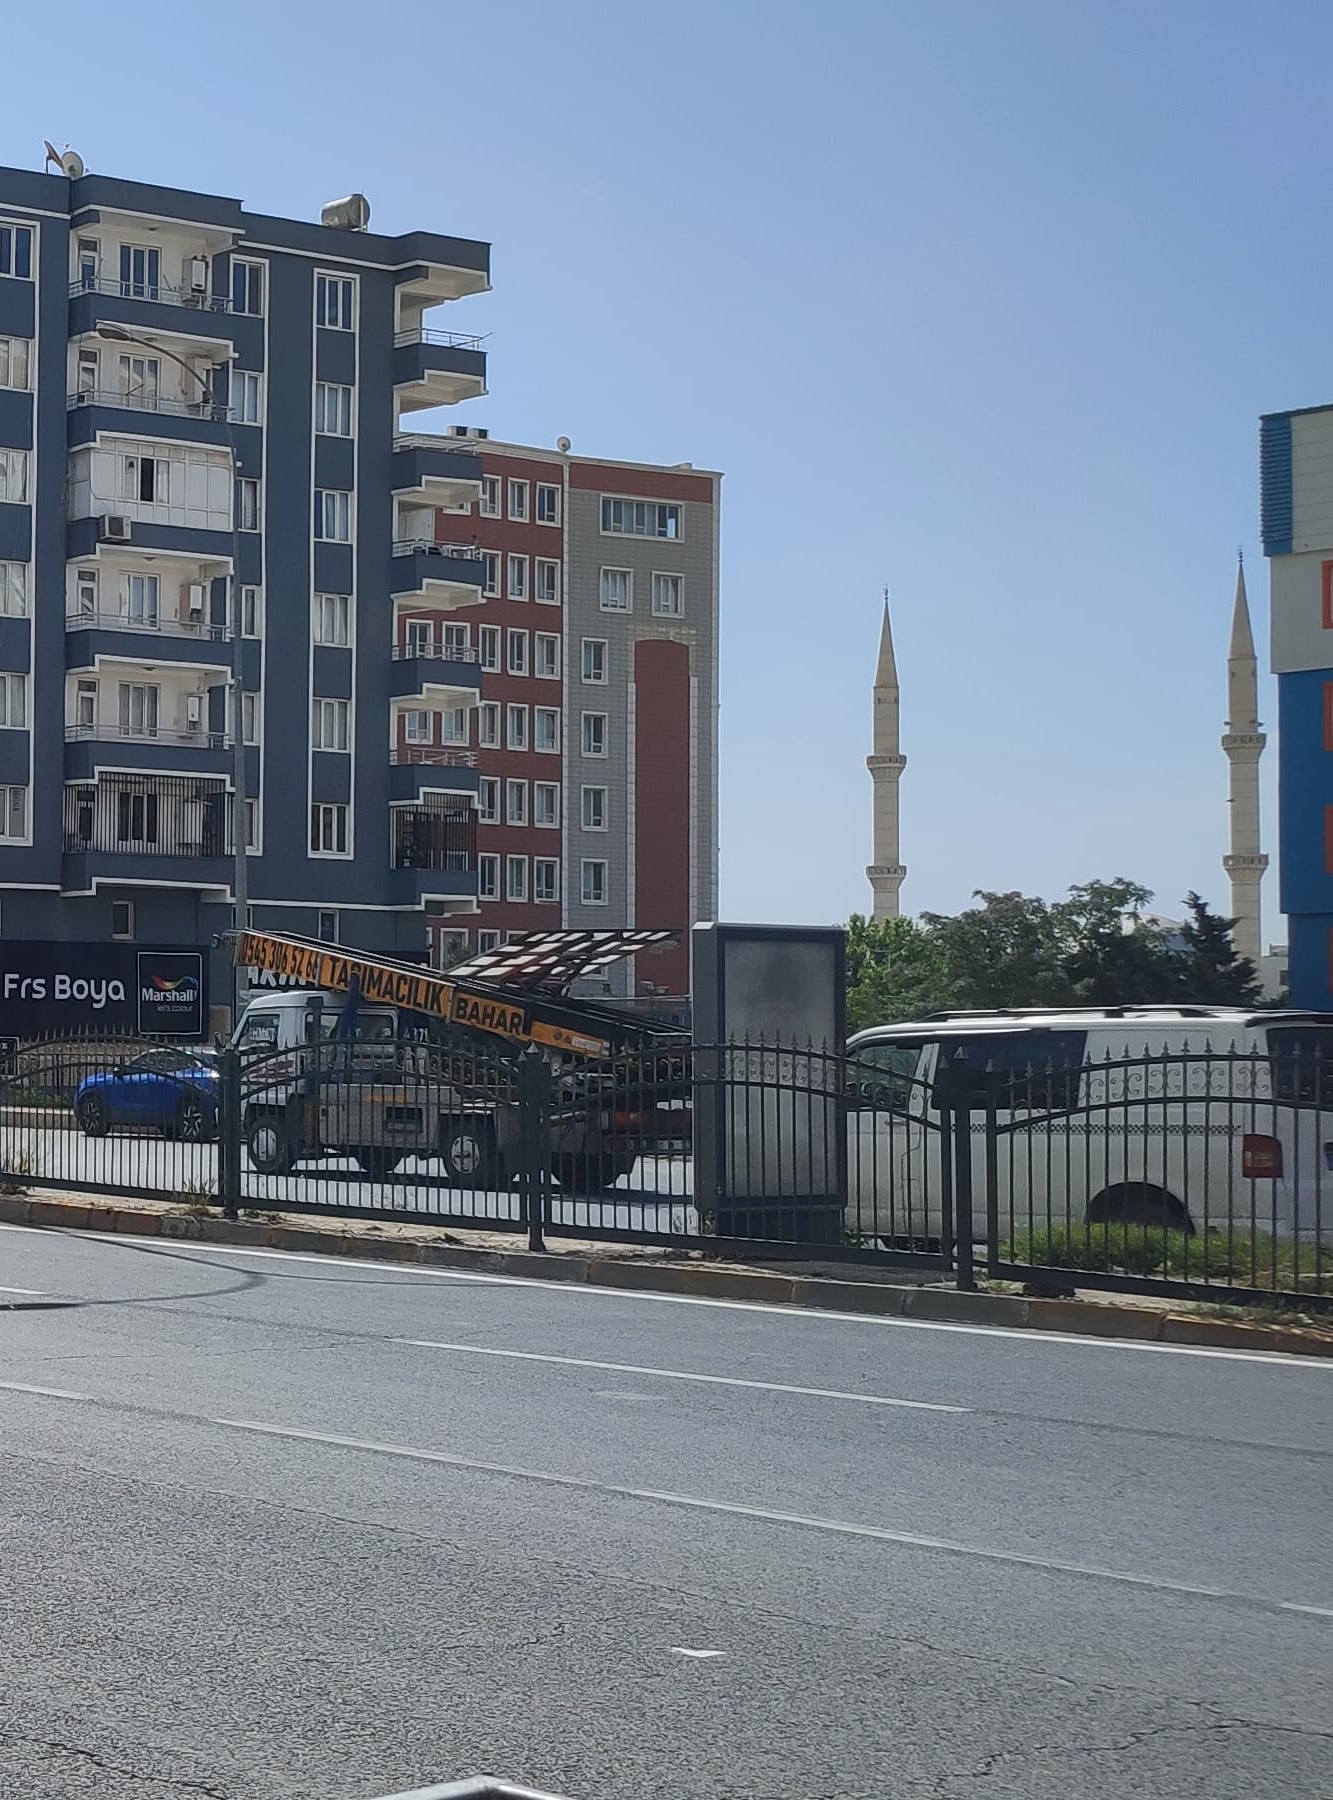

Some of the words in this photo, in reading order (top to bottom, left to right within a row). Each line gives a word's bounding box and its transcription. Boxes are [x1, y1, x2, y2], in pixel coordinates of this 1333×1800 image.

[3, 973, 46, 999] Frs
[54, 974, 126, 1009] Boya
[142, 987, 193, 1002] Marshall
[330, 958, 445, 1015] TAIMACILIK
